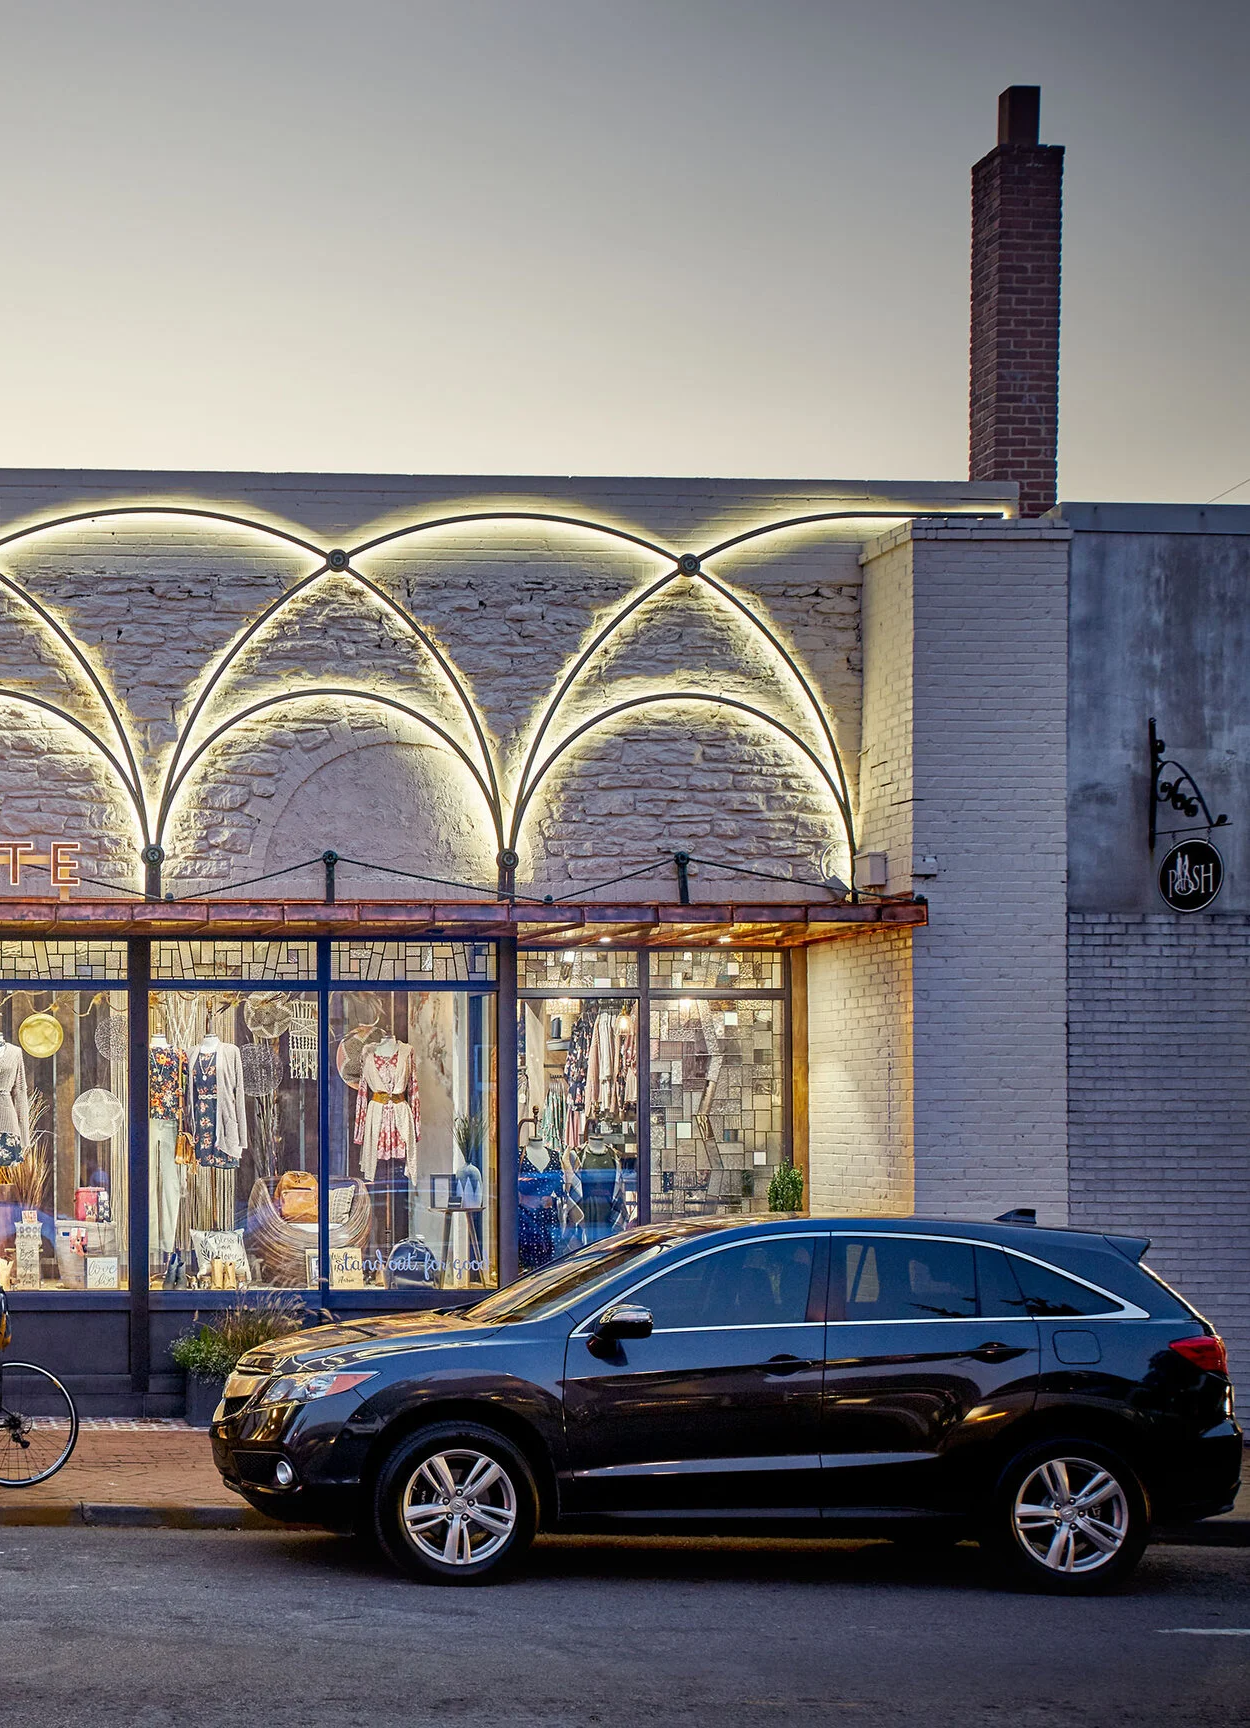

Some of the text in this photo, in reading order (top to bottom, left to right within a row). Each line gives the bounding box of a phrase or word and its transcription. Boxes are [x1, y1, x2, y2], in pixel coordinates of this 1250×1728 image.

[88, 1260, 116, 1276] love
[336, 1249, 385, 1271] stand
[422, 1251, 446, 1281] for
[453, 1251, 490, 1280] good
